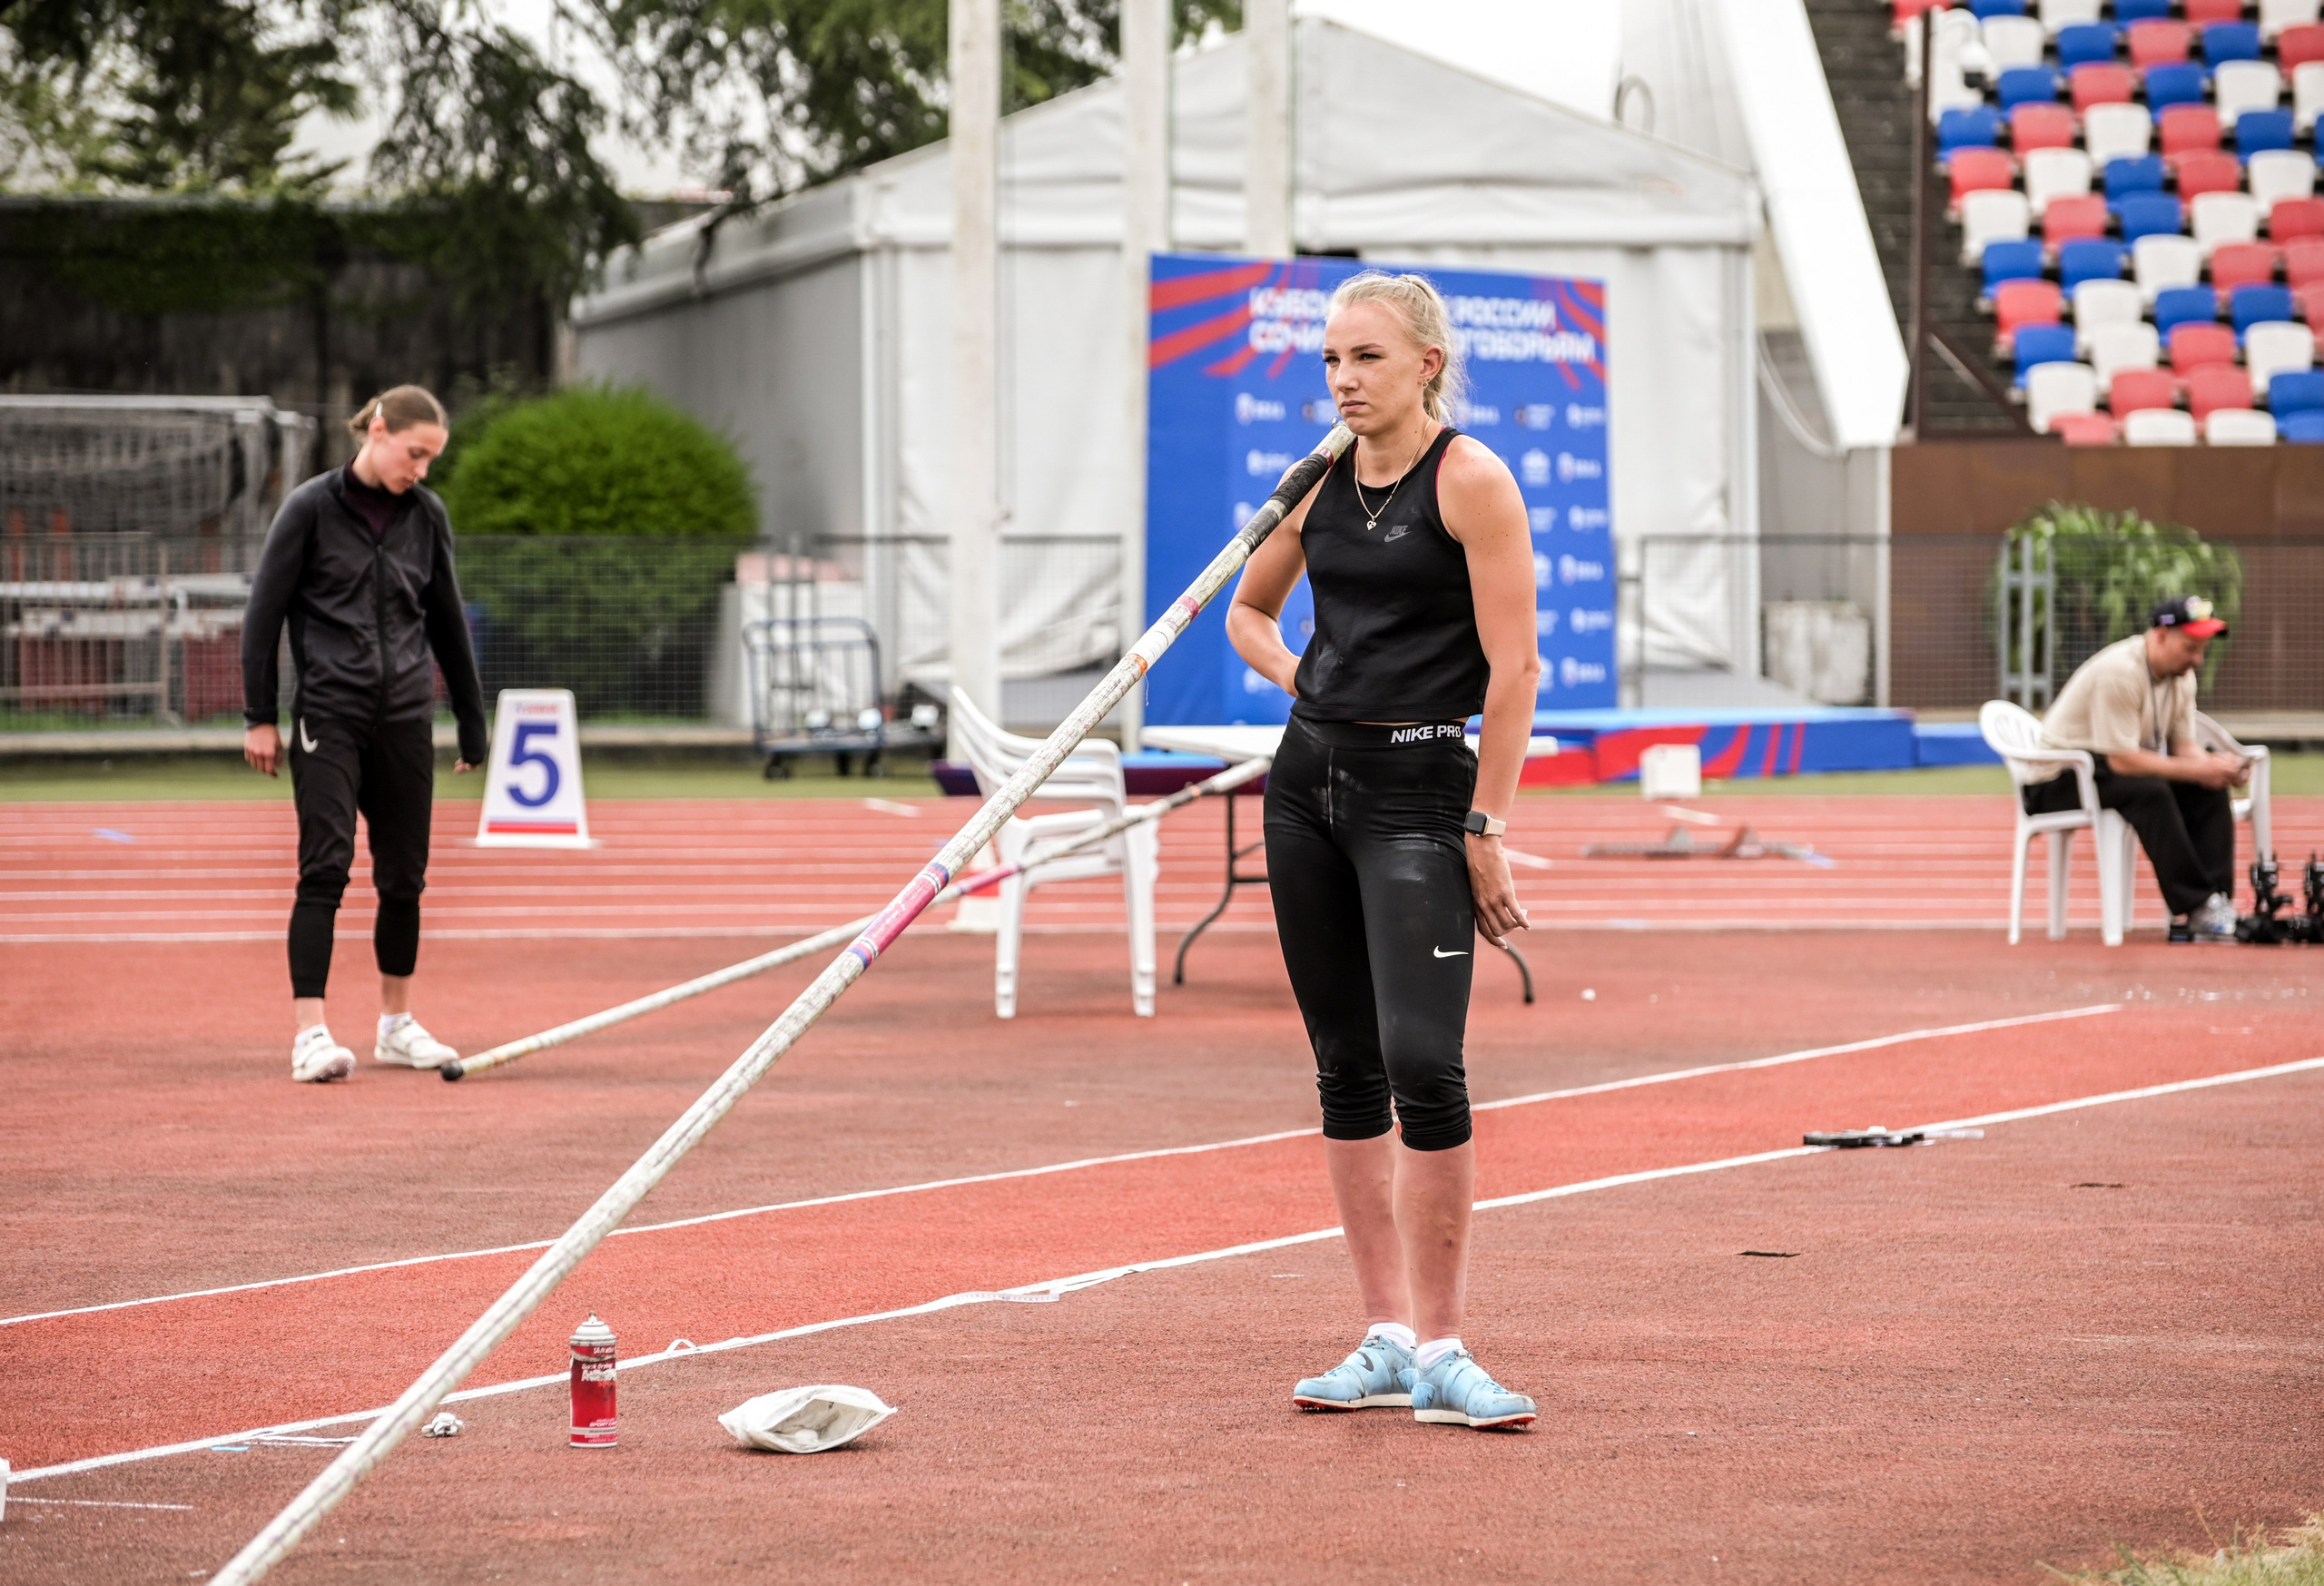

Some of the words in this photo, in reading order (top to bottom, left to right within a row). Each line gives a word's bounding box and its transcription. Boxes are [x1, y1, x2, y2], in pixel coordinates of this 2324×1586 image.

[1248, 287, 1333, 318] КУБО
[1389, 525, 1409, 536] NIKE
[1391, 725, 1434, 744] NIKE
[507, 722, 559, 807] 5
